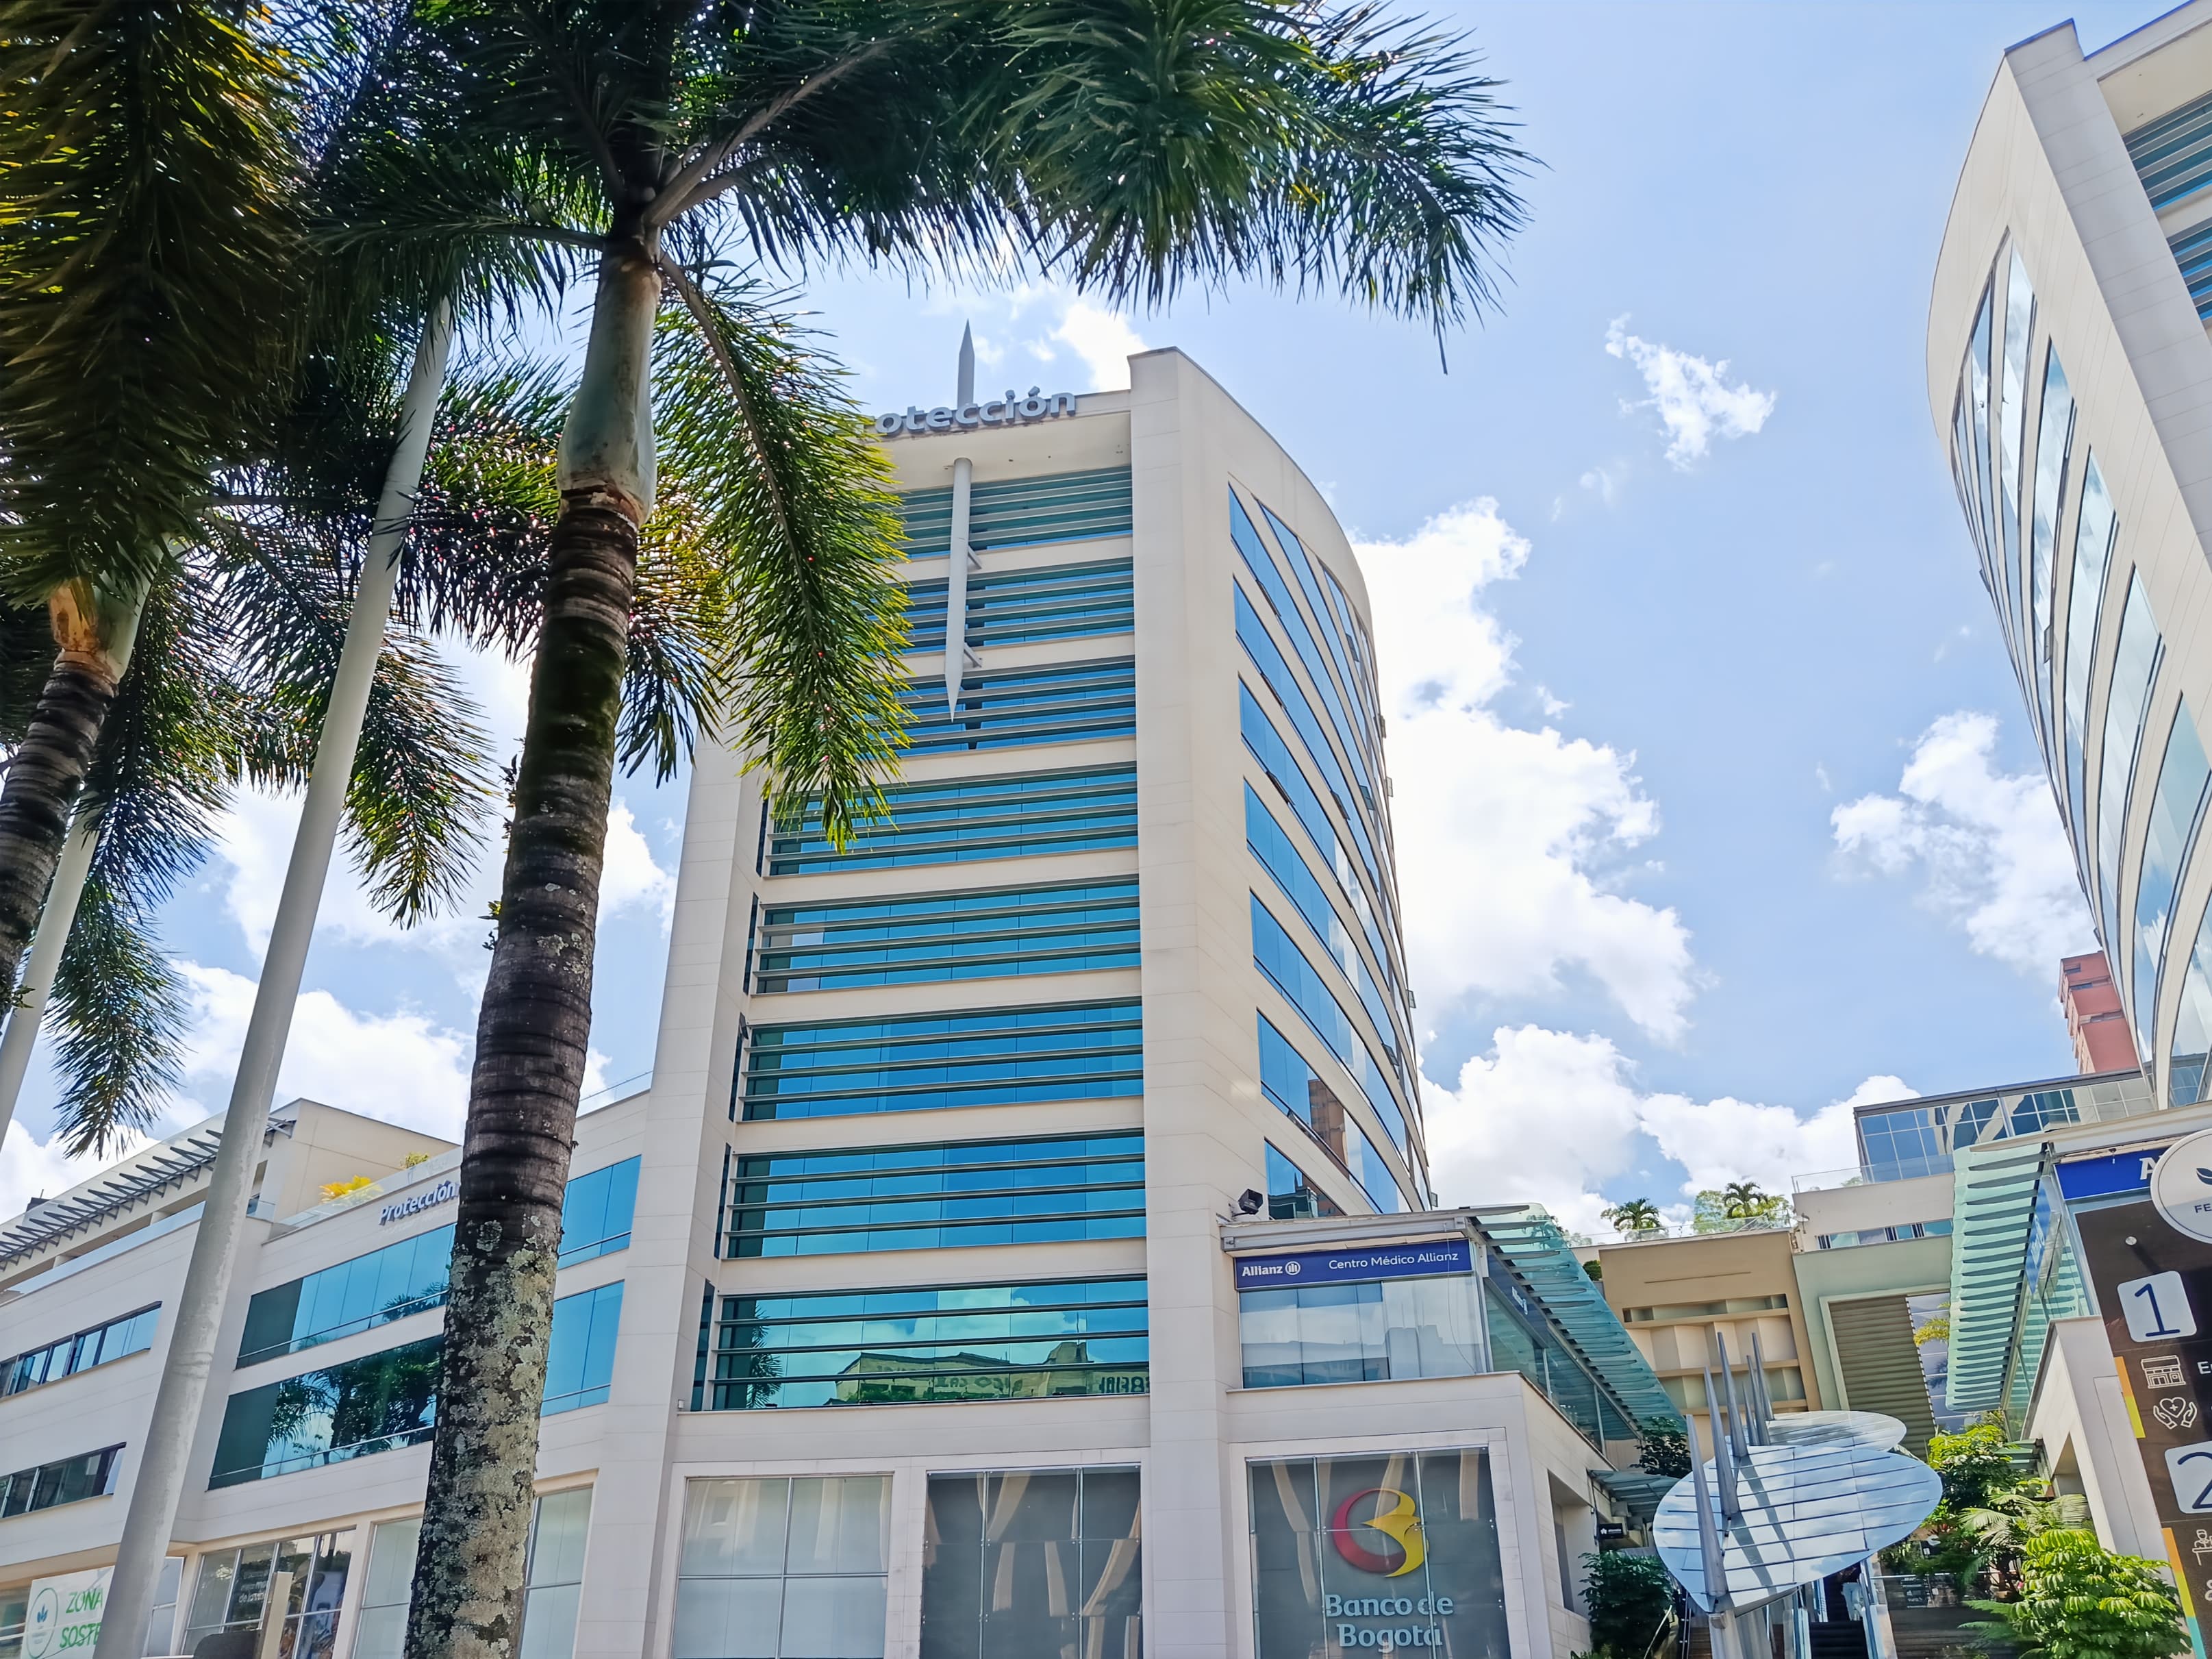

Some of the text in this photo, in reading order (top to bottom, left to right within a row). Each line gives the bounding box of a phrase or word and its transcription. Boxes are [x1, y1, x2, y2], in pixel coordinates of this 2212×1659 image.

[849, 386, 1077, 436] otección
[2139, 1156, 2163, 1180] A
[379, 1180, 459, 1225] Protección
[1242, 1265, 1283, 1277] Allianz
[1329, 1251, 1459, 1271] Centro Médico Allianz
[2134, 1282, 2181, 1337] 1
[2197, 1360, 2212, 1375] E
[2177, 1451, 2212, 1510] 2
[65, 1587, 103, 1614] ZONA
[1324, 1591, 1455, 1617] Banco de
[1336, 1621, 1444, 1653] Bogotá
